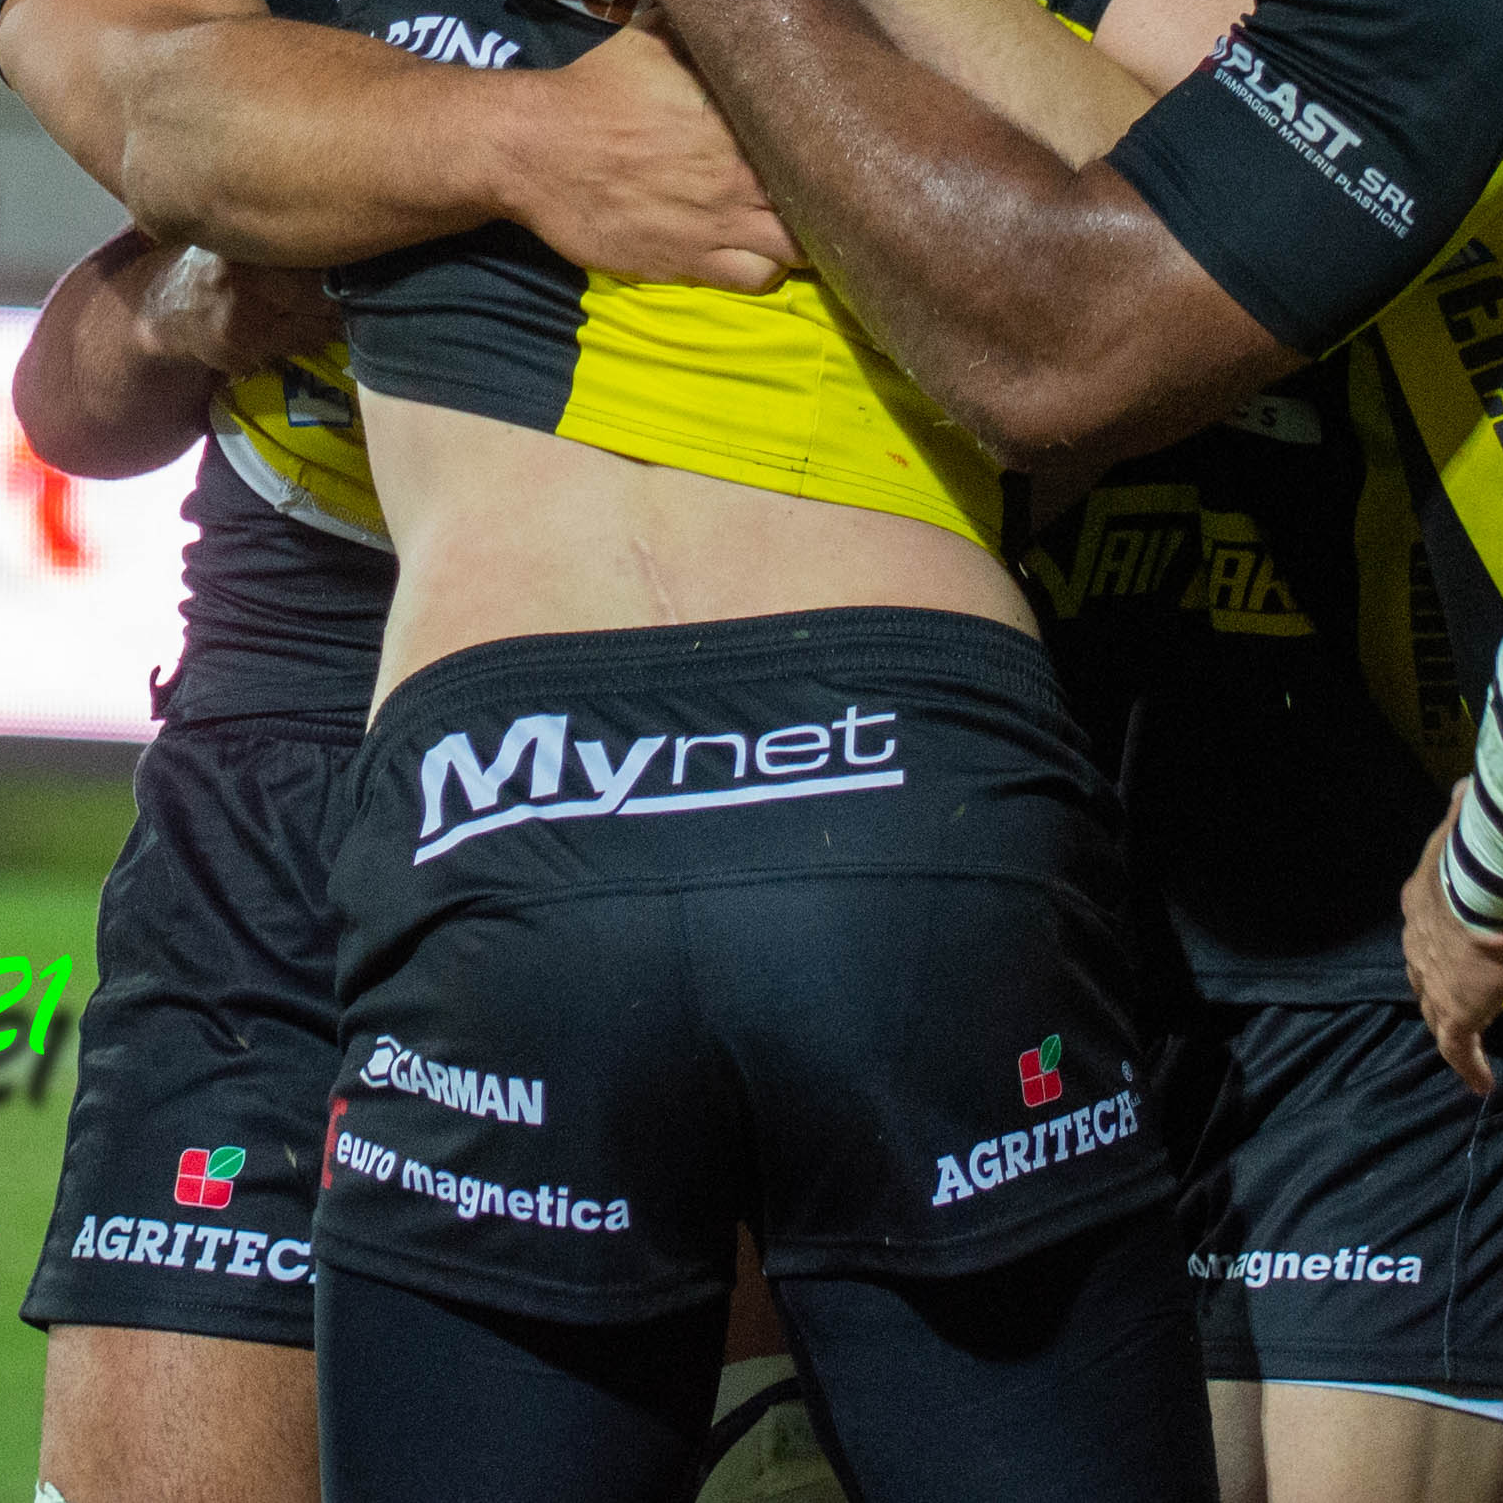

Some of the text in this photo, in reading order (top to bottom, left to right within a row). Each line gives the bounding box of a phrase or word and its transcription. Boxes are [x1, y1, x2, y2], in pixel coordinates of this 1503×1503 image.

[1277, 123, 1338, 180] MATERIE
[1333, 171, 1411, 240] PLASTICHE
[1357, 165, 1415, 227] SRL
[417, 704, 899, 839] Mynet
[389, 1047, 545, 1126] GARMAN
[336, 1130, 631, 1233] euro magnetica
[931, 1088, 1140, 1207] AGRITECH
[70, 1214, 318, 1285] AGRITEC
